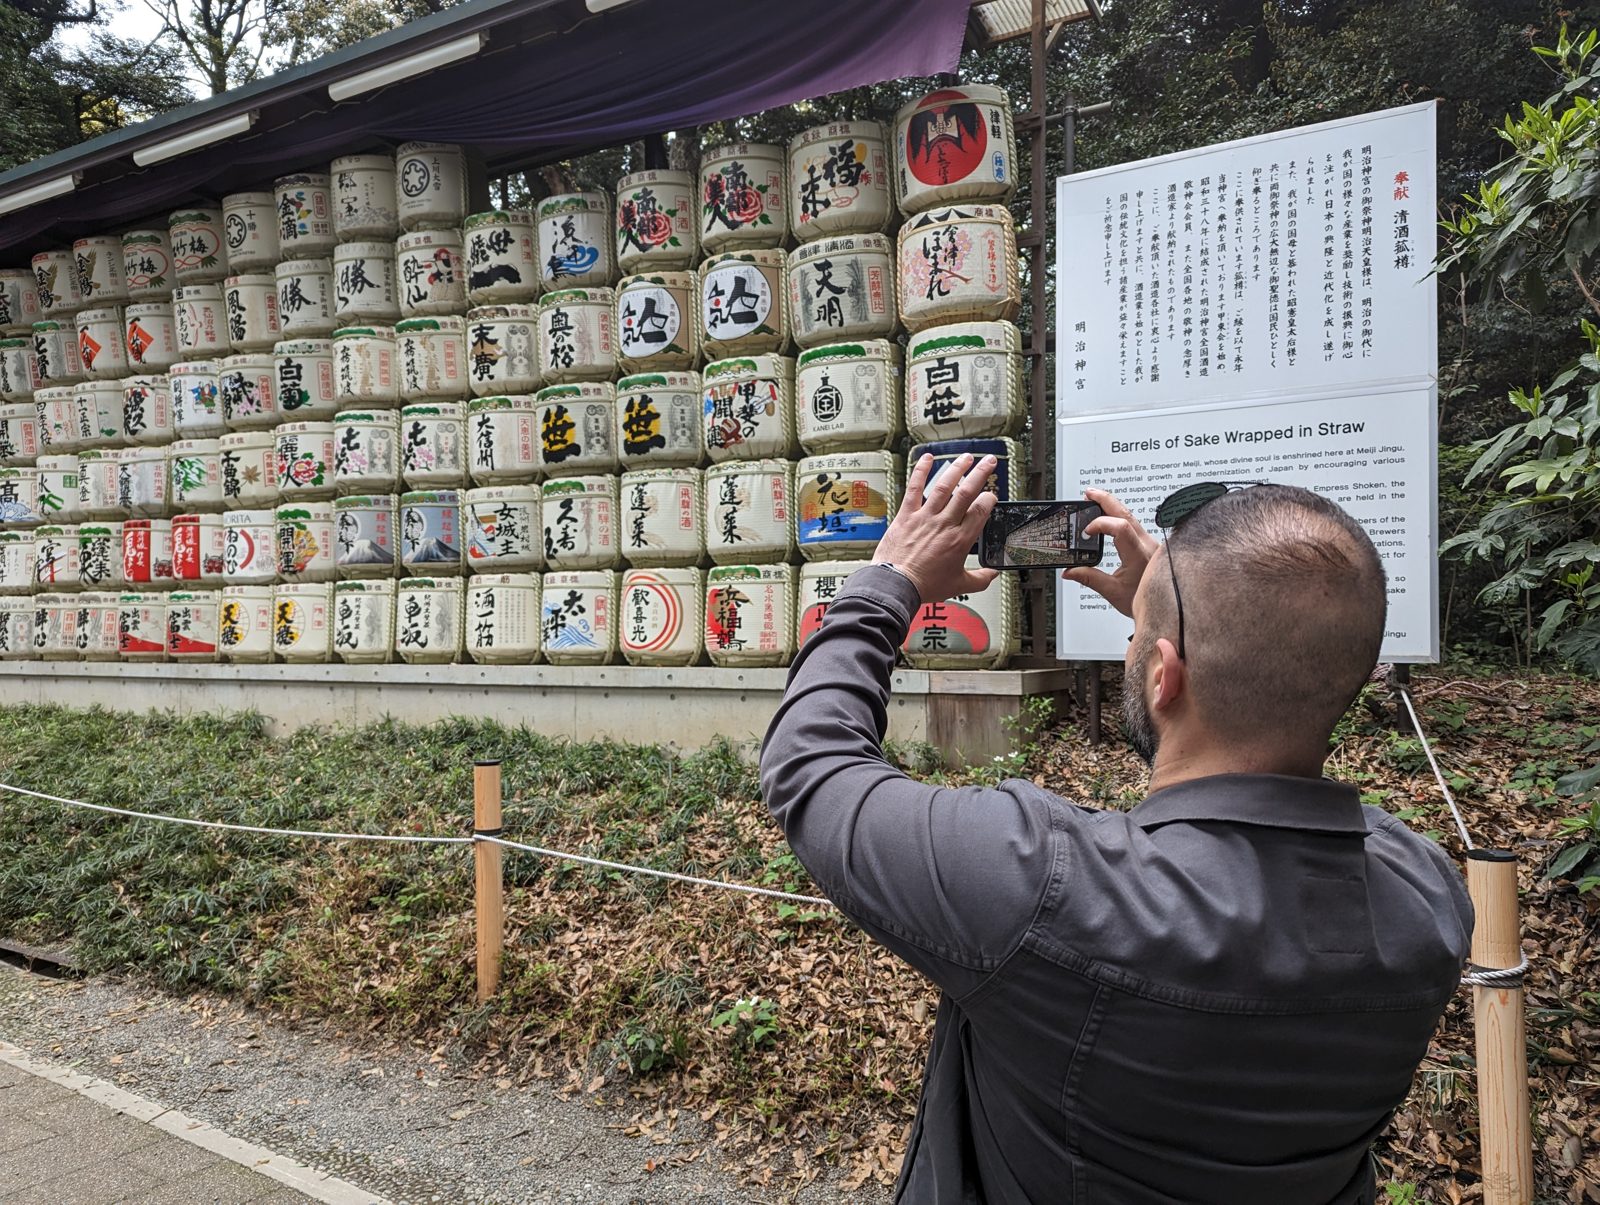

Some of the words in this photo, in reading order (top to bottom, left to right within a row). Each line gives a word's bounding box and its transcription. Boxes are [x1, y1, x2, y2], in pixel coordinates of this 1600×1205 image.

[768, 174, 781, 208] 清酒
[1306, 156, 1316, 206] られました
[1392, 170, 1411, 202] 奉献
[676, 200, 690, 229] 清酒
[922, 230, 950, 301] ほまれ
[812, 257, 848, 328] 天明
[547, 306, 577, 370] 奥の松
[1074, 320, 1087, 391] 明治神宮
[278, 356, 304, 411] 白菊
[476, 412, 496, 471] 大信州
[831, 422, 845, 430] LAB
[1111, 438, 1161, 453] Barrels
[1165, 436, 1180, 449] of
[1184, 433, 1220, 447] Sake
[1224, 425, 1294, 444] Wrapped
[1299, 424, 1313, 438] in
[1318, 421, 1365, 436] Straw
[221, 450, 242, 499] 千曲錦
[808, 458, 862, 471] 日本百名水
[1079, 467, 1102, 476] During
[1116, 465, 1133, 473] Meiji
[1150, 461, 1181, 471] Emperor
[1204, 458, 1228, 466] whose
[1230, 456, 1253, 464] divine
[1255, 455, 1272, 463] soul
[1282, 451, 1323, 461] enshrined
[1324, 449, 1344, 457] here
[1356, 446, 1377, 455] Meiji
[1110, 475, 1143, 484] industrial
[1147, 473, 1173, 482] growth
[1196, 468, 1251, 478] modernization
[1255, 466, 1264, 474] of
[1268, 464, 1294, 473] Japan
[1298, 463, 1309, 471] by
[1313, 459, 1368, 470] encouraging
[1372, 456, 1406, 465] various
[1129, 484, 1167, 496] supporting
[1313, 485, 1350, 493] Empress
[1355, 493, 1375, 501] held
[494, 501, 520, 558] 女城主
[597, 500, 611, 546] 飛騨の酒
[1369, 528, 1406, 536] Brewers
[1380, 516, 1389, 524] of
[226, 527, 239, 575] ねのひ
[474, 587, 496, 649] 酒一筋
[1080, 603, 1107, 611] brewing
